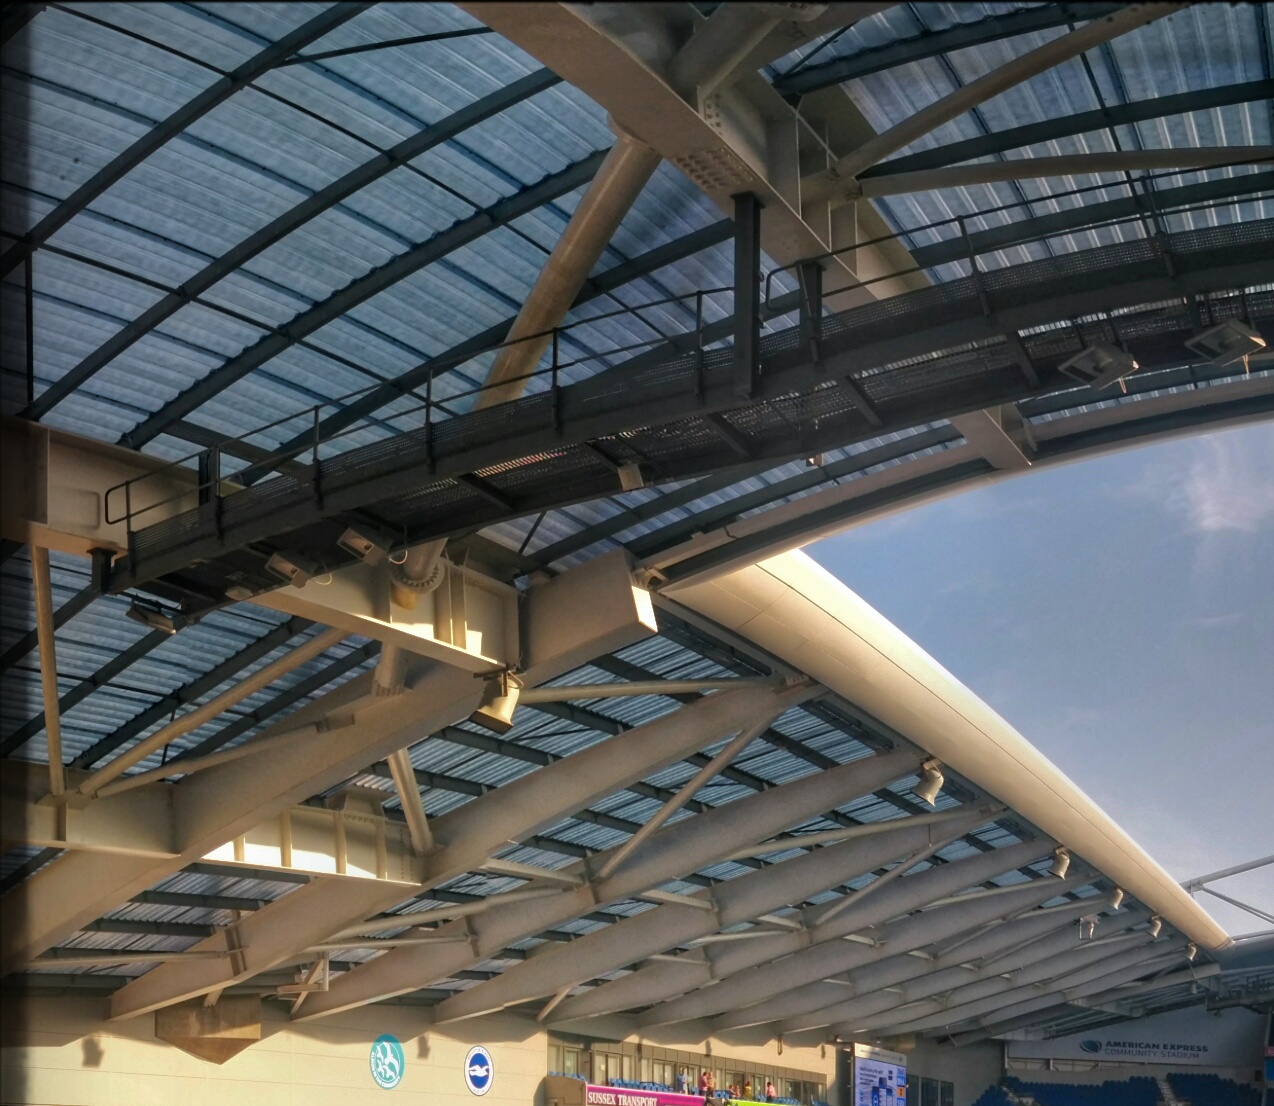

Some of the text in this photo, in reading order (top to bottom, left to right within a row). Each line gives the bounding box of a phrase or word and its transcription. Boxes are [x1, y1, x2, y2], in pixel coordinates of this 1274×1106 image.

[1105, 1041, 1208, 1052] AMERICAN EXPRESS
[1104, 1048, 1157, 1057] COMMUNITY
[588, 1091, 616, 1105] SUSSEX
